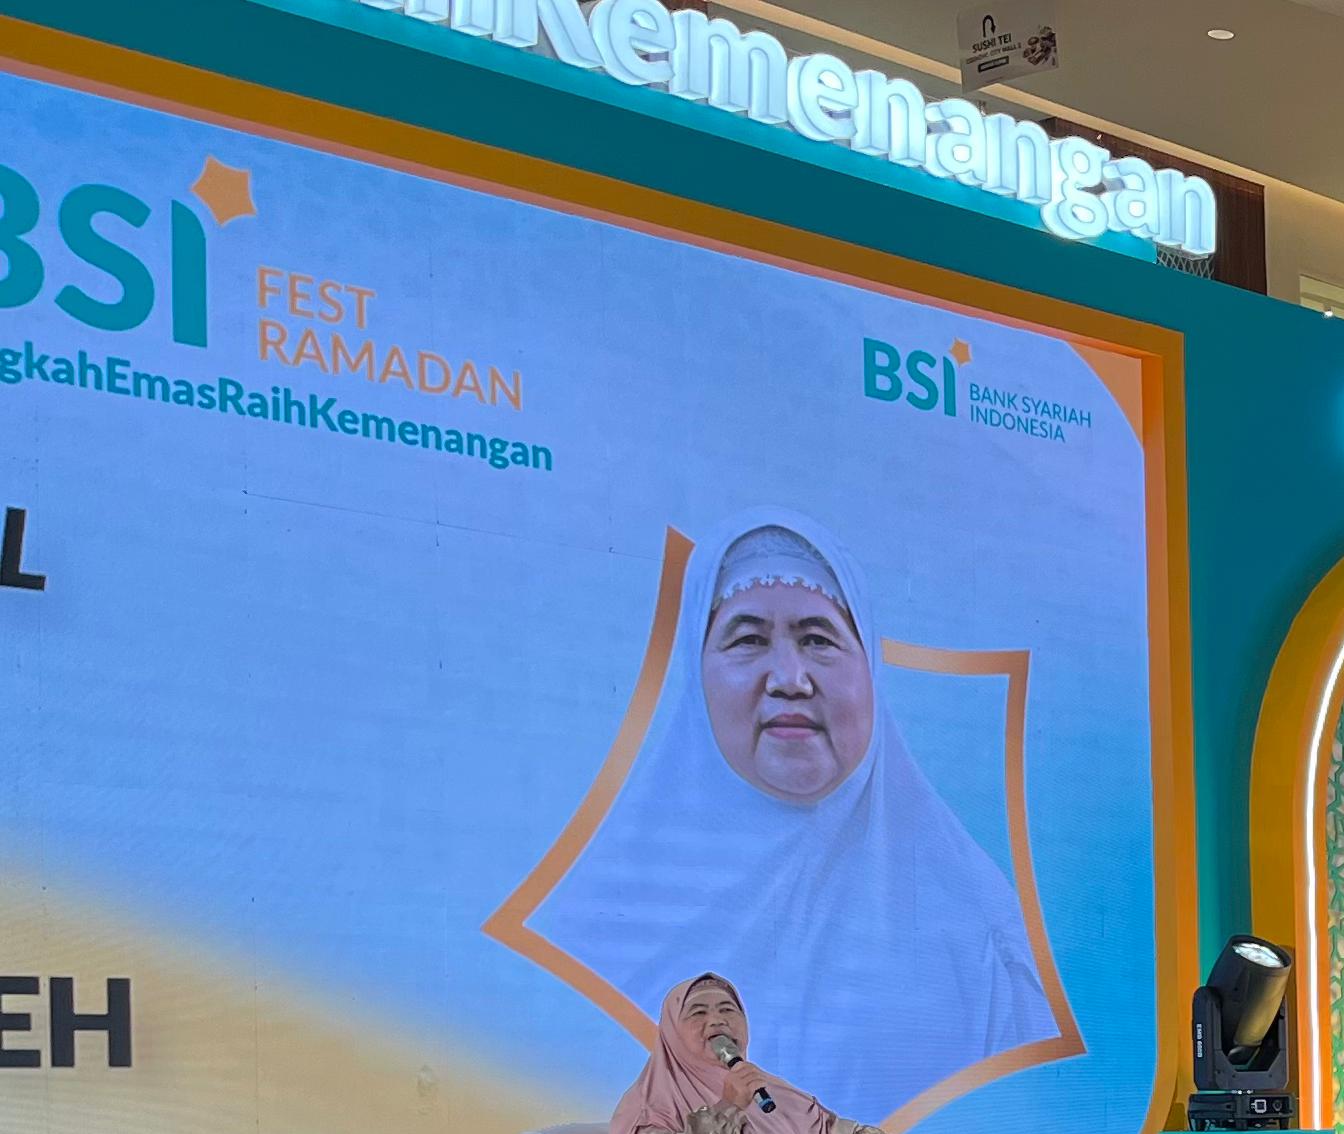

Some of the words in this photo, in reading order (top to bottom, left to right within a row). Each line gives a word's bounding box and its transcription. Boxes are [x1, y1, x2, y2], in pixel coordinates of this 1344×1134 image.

[972, 37, 997, 53] SUSHI
[998, 33, 1012, 45] TEI
[257, 267, 376, 329] FEST
[258, 319, 522, 411] RAMADAN
[863, 337, 957, 416] BSI
[969, 383, 1018, 412] BANK
[1021, 394, 1092, 430] SYARIAH
[969, 404, 1067, 444] INDONESIA
[0, 976, 132, 1068] EH
